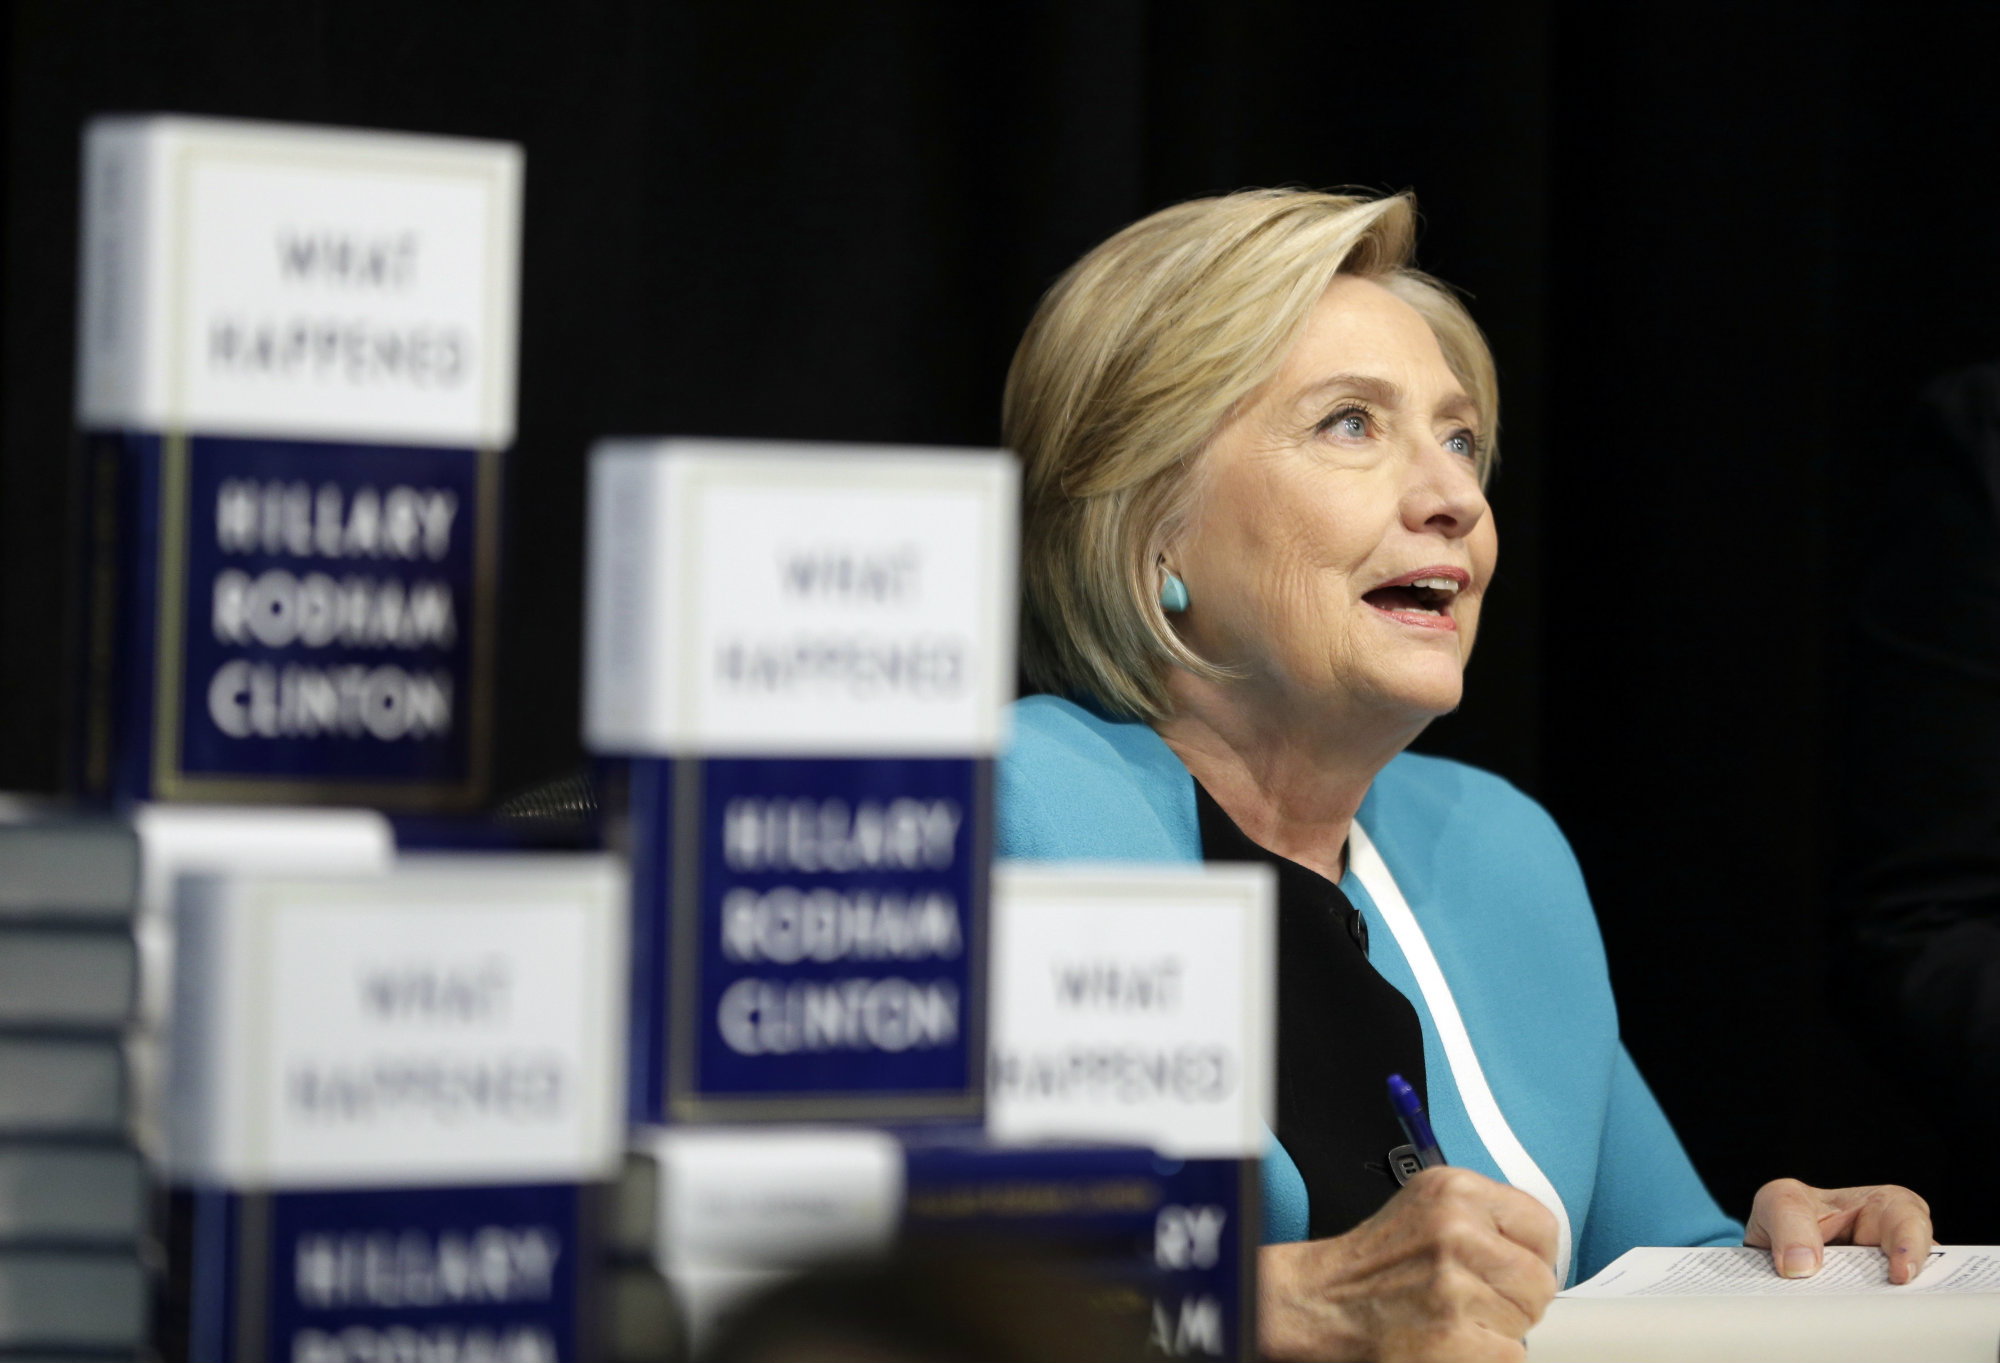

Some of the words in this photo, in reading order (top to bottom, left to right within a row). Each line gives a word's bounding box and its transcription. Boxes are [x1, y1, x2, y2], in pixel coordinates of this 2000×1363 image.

[278, 228, 417, 288] WHAT
[209, 321, 469, 389] HAPPENED
[217, 478, 456, 559] HILLARY
[213, 570, 455, 648] RODHAM
[779, 546, 916, 603] WHAT
[208, 661, 453, 738] CLINTON
[716, 637, 964, 697] HAPPENED
[724, 798, 960, 871] HILLARY
[722, 887, 960, 963] RODHAM
[718, 978, 959, 1055] CLINTON
[1053, 957, 1182, 1014] WHAT
[295, 1228, 558, 1307] HILLARY
